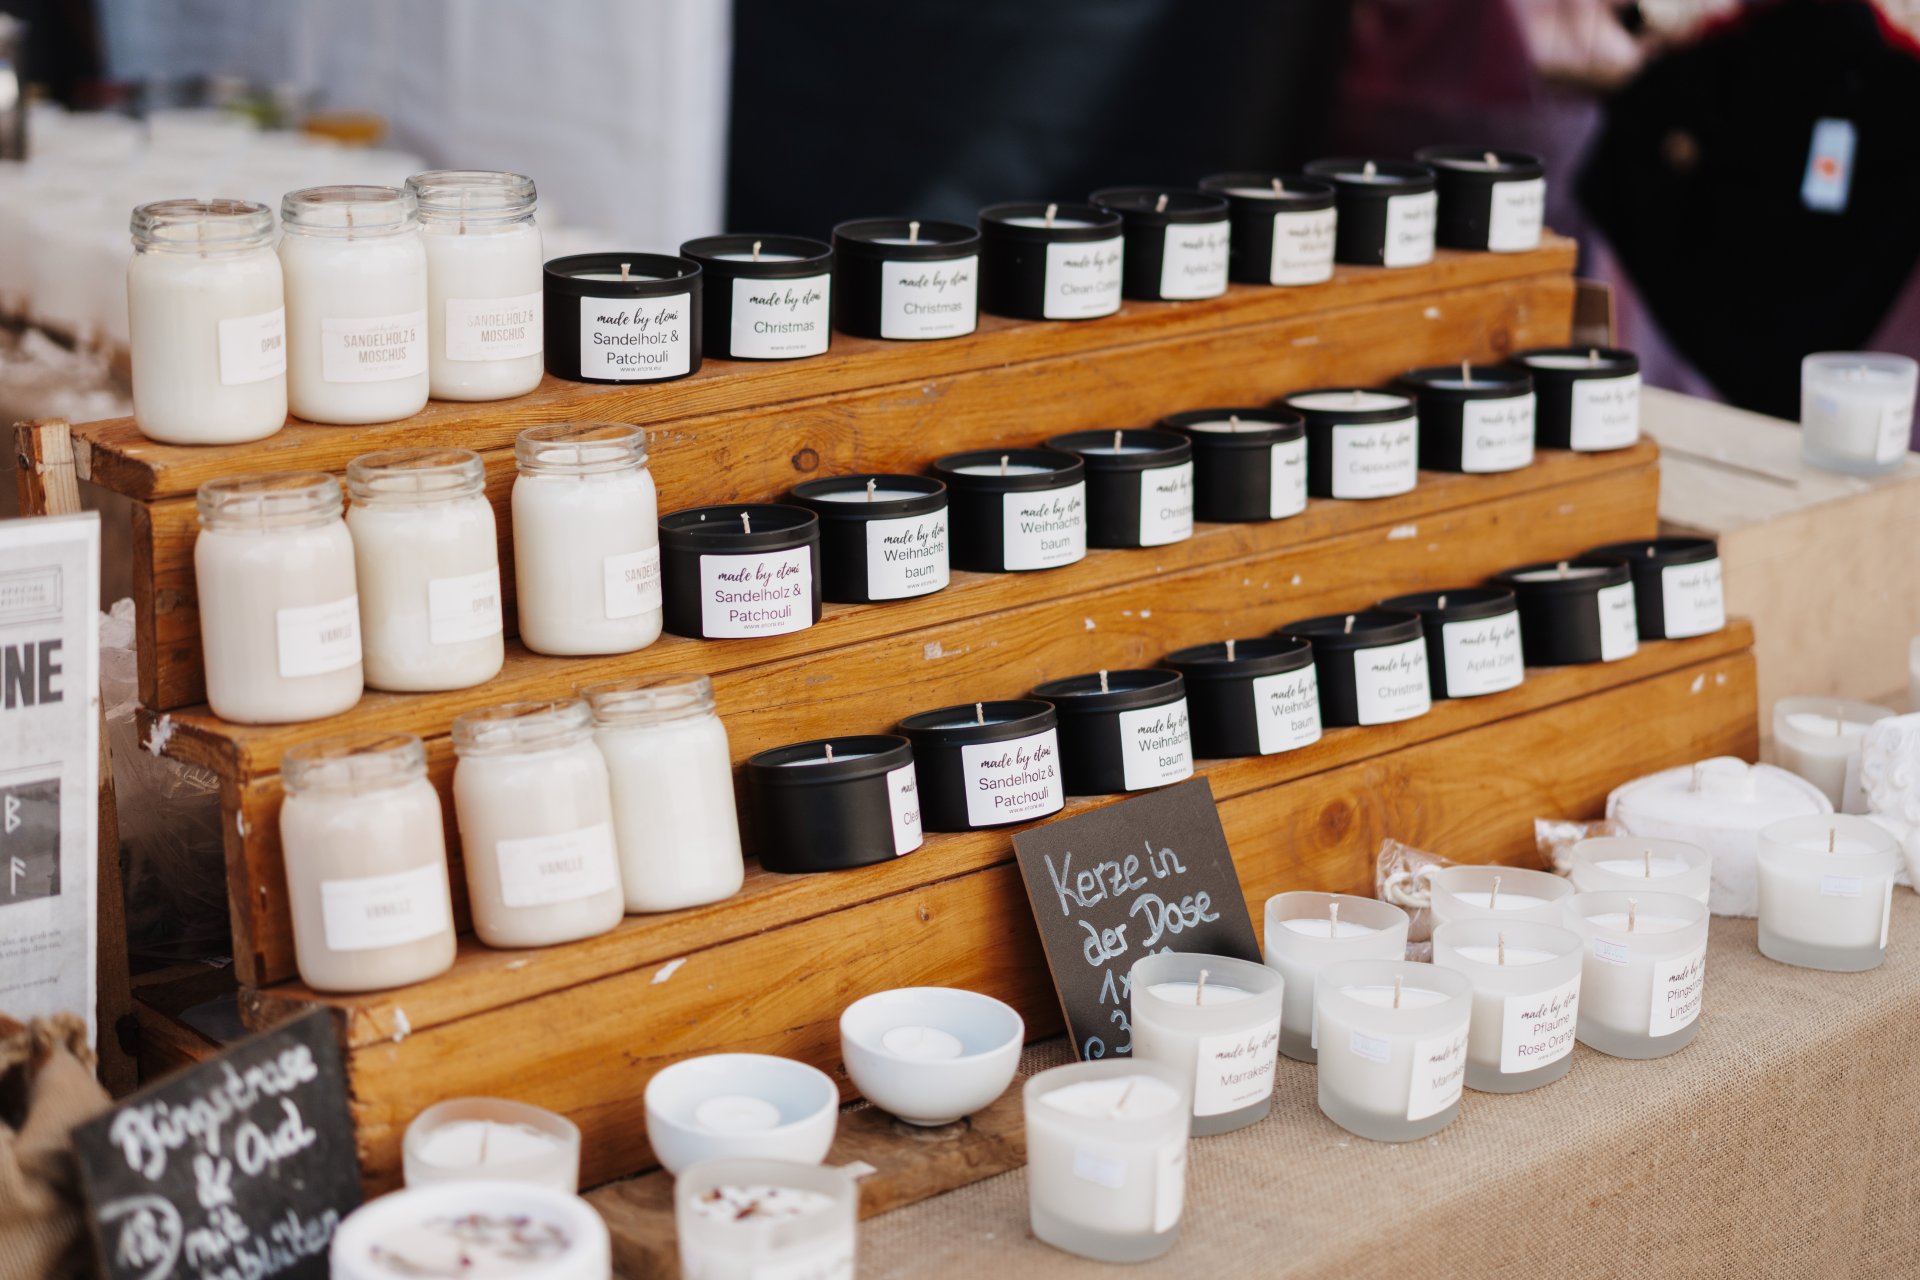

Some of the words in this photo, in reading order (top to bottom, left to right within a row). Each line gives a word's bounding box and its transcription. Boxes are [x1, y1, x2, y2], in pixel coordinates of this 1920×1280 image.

[898, 272, 928, 288] made
[932, 270, 947, 293] by
[1060, 283, 1093, 297] Clean
[750, 293, 780, 306] made
[784, 288, 799, 311] by
[904, 301, 963, 315] Christmas
[468, 311, 527, 328] SANDELHOLZ
[597, 311, 630, 325] made
[633, 308, 650, 331] by
[655, 308, 679, 325] etoni
[754, 320, 815, 334] Christmas
[343, 331, 407, 349] SANDELHOLZ
[409, 328, 416, 342] &
[481, 326, 525, 343] MOSCHUS
[593, 331, 668, 347] Sandelholz
[670, 330, 679, 342] &
[358, 346, 407, 364] MOSCHUS
[607, 351, 669, 365] Patchouli
[1020, 504, 1049, 517] made
[1051, 498, 1063, 519] by
[1020, 516, 1080, 534] Weihnachts
[884, 530, 914, 544] made
[917, 525, 929, 547] by
[1040, 535, 1070, 550] baum
[884, 543, 945, 562] Weihnachts
[718, 568, 751, 582] made
[755, 562, 773, 587] by
[777, 562, 800, 579] etoni
[905, 564, 935, 579] baum
[715, 586, 790, 604] Sandelholz
[792, 584, 802, 596] &
[729, 605, 792, 623] Patchouli
[1371, 657, 1398, 673] made
[1400, 653, 1411, 670] by
[0, 638, 63, 710] NE
[1270, 686, 1295, 700] made
[1297, 679, 1308, 698] by
[1137, 723, 1164, 735] made
[1166, 712, 1177, 737] by
[1291, 717, 1313, 731] baum
[981, 752, 1012, 769] made
[1016, 747, 1031, 770] by
[1034, 744, 1052, 762] etoni
[1158, 753, 1184, 768] baum
[979, 769, 1046, 790] Sandelholz
[1047, 765, 1055, 778] &
[994, 786, 1049, 808] Patchouli
[1043, 851, 1148, 916] Kerze
[1144, 840, 1186, 879] in
[1078, 920, 1127, 967] der
[1129, 891, 1220, 947] Dose
[1669, 966, 1690, 983] made
[1690, 958, 1699, 975] by
[1520, 1003, 1548, 1020] made
[1550, 997, 1561, 1019] by
[1532, 1013, 1570, 1036] Pflaume
[1215, 1042, 1244, 1060] made
[1247, 1036, 1259, 1058] by
[1429, 1048, 1451, 1064] made
[1517, 1041, 1545, 1057] Rose
